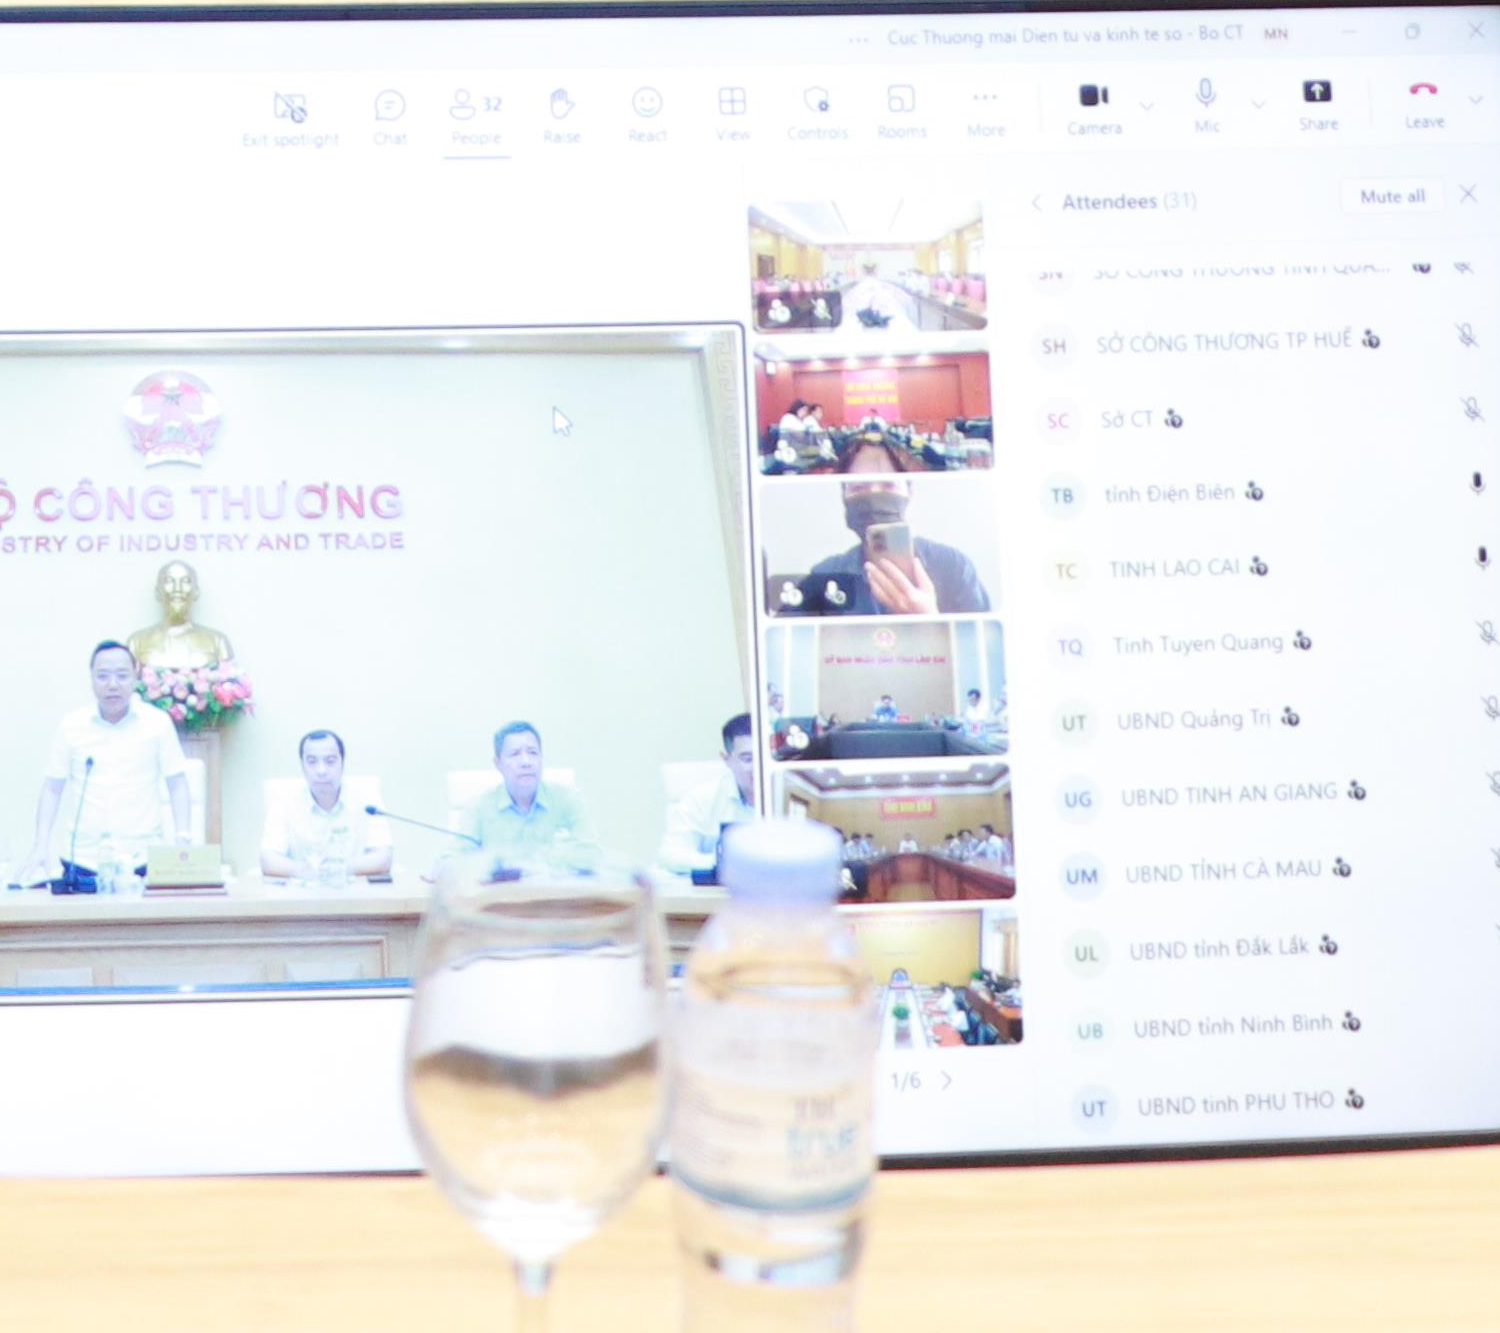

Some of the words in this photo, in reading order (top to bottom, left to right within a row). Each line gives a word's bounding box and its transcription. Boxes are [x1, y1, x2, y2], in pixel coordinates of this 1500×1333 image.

[887, 29, 917, 46] Cuc
[922, 29, 984, 49] Thuong
[989, 33, 1017, 44] mai
[1022, 28, 1058, 43] Dien
[1063, 30, 1079, 43] tu
[1084, 31, 1101, 42] va
[1106, 27, 1139, 41] kinh
[1144, 29, 1159, 41] te
[1164, 30, 1183, 41] so
[1199, 25, 1220, 40] Bo
[1223, 24, 1244, 40] CT
[484, 97, 502, 112] 32
[967, 124, 1006, 137] More
[1068, 122, 1123, 135] Camera
[1195, 120, 1220, 133] Mic
[1300, 118, 1339, 131] Share
[1406, 117, 1445, 129] Leave
[374, 132, 407, 145] Chat
[452, 131, 502, 145] People
[544, 130, 581, 143] Raise
[629, 129, 667, 142] React
[717, 130, 750, 141] View
[787, 126, 849, 140] Controls
[877, 125, 927, 139] Rooms
[243, 133, 268, 147] Exit
[273, 133, 339, 149] spotlight
[1063, 194, 1157, 210] Attendees
[1163, 191, 1198, 212] (31)
[1361, 190, 1402, 204] Mute
[1408, 188, 1426, 203] all
[1042, 339, 1066, 354] SH
[1129, 332, 1188, 353] CÔNG
[1194, 332, 1279, 351] THƯƠNG
[1286, 331, 1307, 348] TP
[1047, 413, 1069, 430] SC
[1131, 409, 1153, 428] CT
[33, 478, 173, 523] CÔNG
[191, 480, 402, 521] THƯƠNG
[1052, 488, 1074, 504] TB
[1196, 483, 1235, 501] Biên
[76, 535, 110, 553] OF
[119, 533, 249, 552] INDUSTRY
[256, 533, 310, 551] AND
[318, 532, 405, 550] TRADE
[1056, 563, 1077, 579] TC
[1207, 558, 1240, 576] CAI
[1058, 638, 1083, 657] TQ
[1160, 635, 1215, 656] Tuyen
[1221, 633, 1284, 654] Quang
[1062, 714, 1086, 732] UT
[1118, 711, 1174, 730] UBND
[1065, 791, 1092, 808] UG
[1122, 788, 1179, 807] UBND
[1239, 785, 1267, 801] AN
[1274, 782, 1338, 801] GIANG
[1066, 869, 1098, 885] UM
[1126, 864, 1183, 884] UBND
[1242, 858, 1270, 879] CÀ
[1276, 860, 1321, 877] MAU
[1075, 946, 1099, 962] UL
[1130, 941, 1187, 961] UBND
[1078, 1023, 1104, 1040] UB
[1134, 1019, 1191, 1038] UBND
[1241, 1016, 1285, 1033] Ninh
[891, 1071, 921, 1092] 1/6
[1082, 1100, 1106, 1118] UT
[1138, 1096, 1196, 1116] UBND
